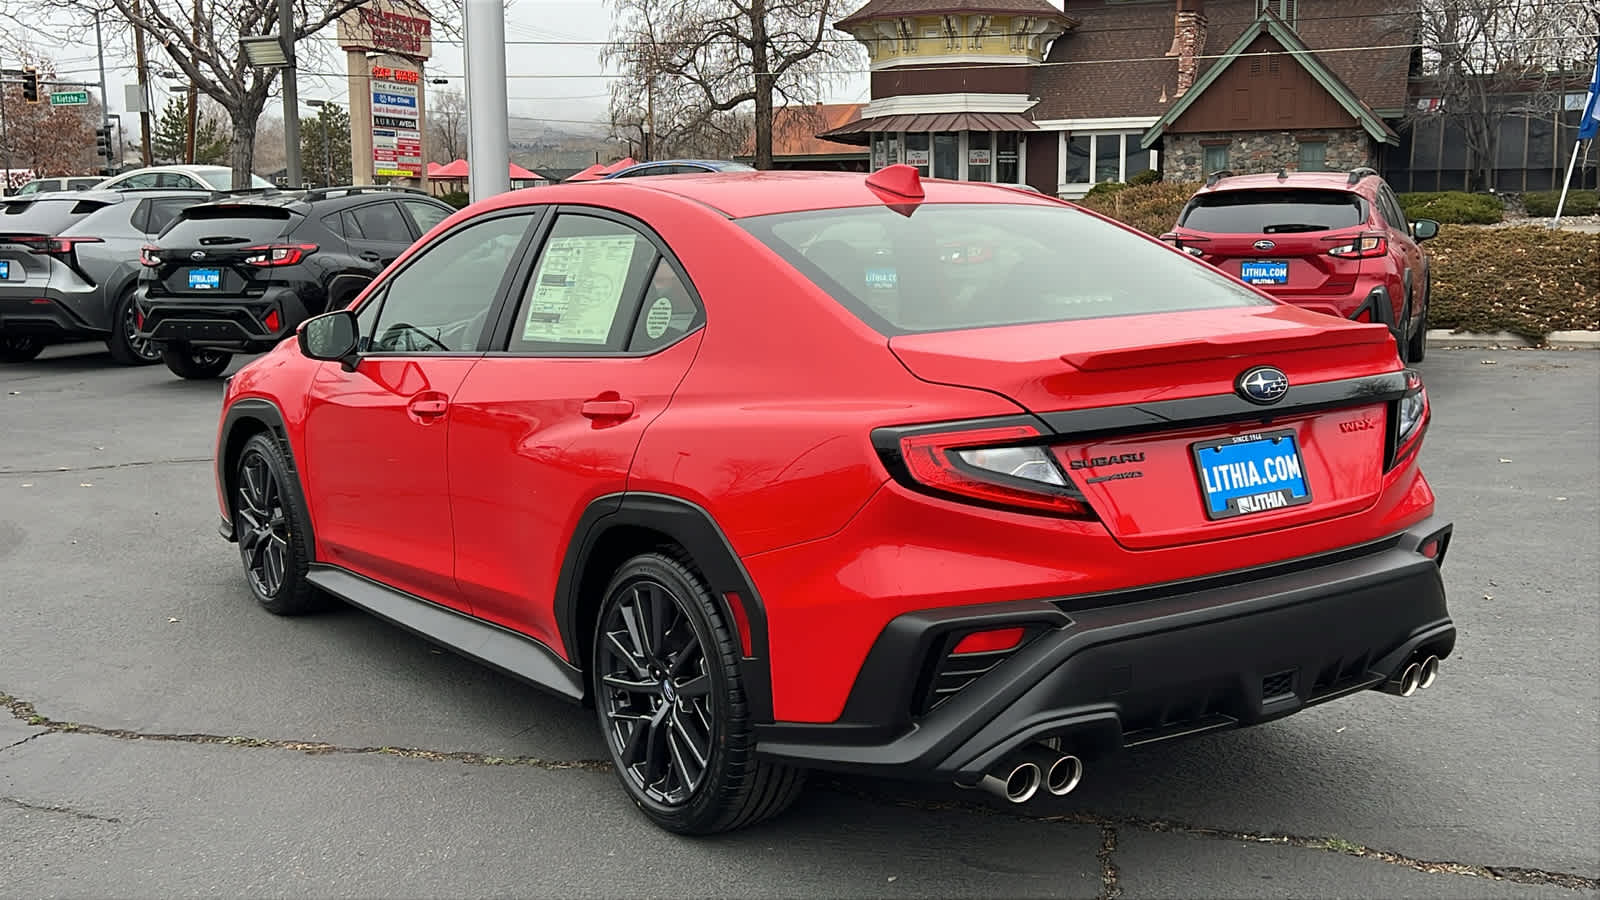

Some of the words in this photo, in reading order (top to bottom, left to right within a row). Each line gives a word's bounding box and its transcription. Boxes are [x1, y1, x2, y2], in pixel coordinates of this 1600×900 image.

[373, 66, 391, 78] CAR
[394, 70, 418, 82] WASH
[375, 118, 395, 126] AURA
[189, 274, 219, 283] LITHIA.COM
[1242, 268, 1287, 277] LITHIA.COM
[1338, 418, 1376, 433] WRX
[1232, 435, 1249, 444] SINCE
[1070, 452, 1145, 470] SUBARU
[1110, 471, 1144, 481] AWD
[1202, 453, 1302, 494] LITHIA.COM
[1247, 491, 1288, 512] LITHIA
